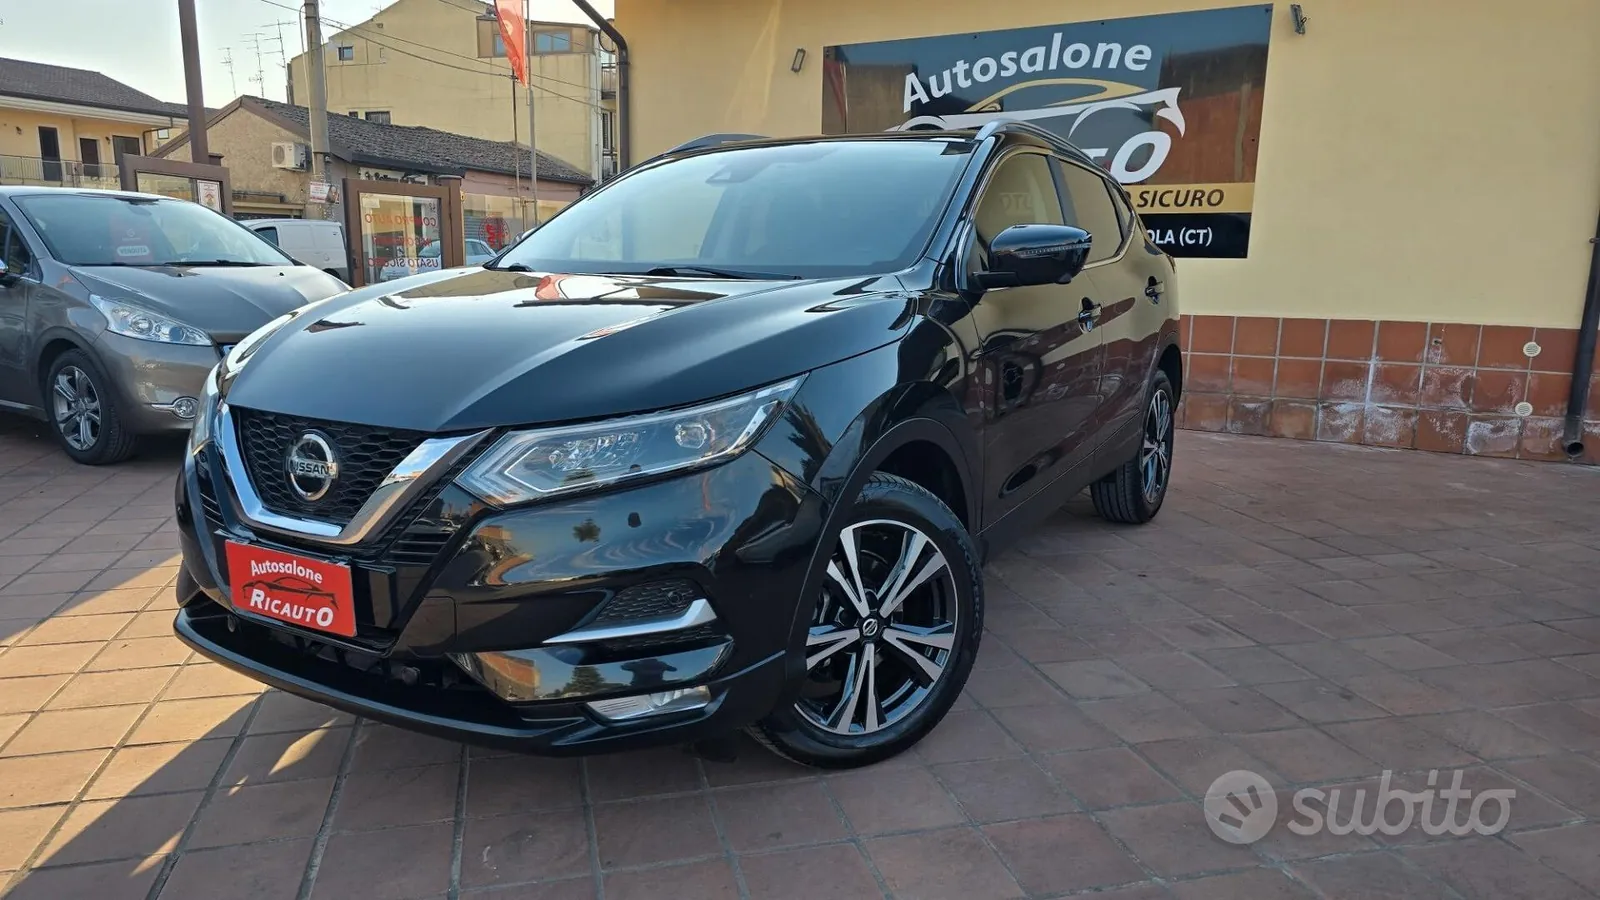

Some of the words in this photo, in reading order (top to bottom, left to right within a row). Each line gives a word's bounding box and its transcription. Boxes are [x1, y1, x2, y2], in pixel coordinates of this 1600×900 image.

[902, 32, 1152, 112] Autosalone
[1137, 189, 1225, 208] SICURO
[1179, 226, 1213, 247] (CT)
[289, 458, 330, 476] NISSAN
[251, 559, 323, 584] Autosalone
[250, 588, 334, 627] RICAUTO
